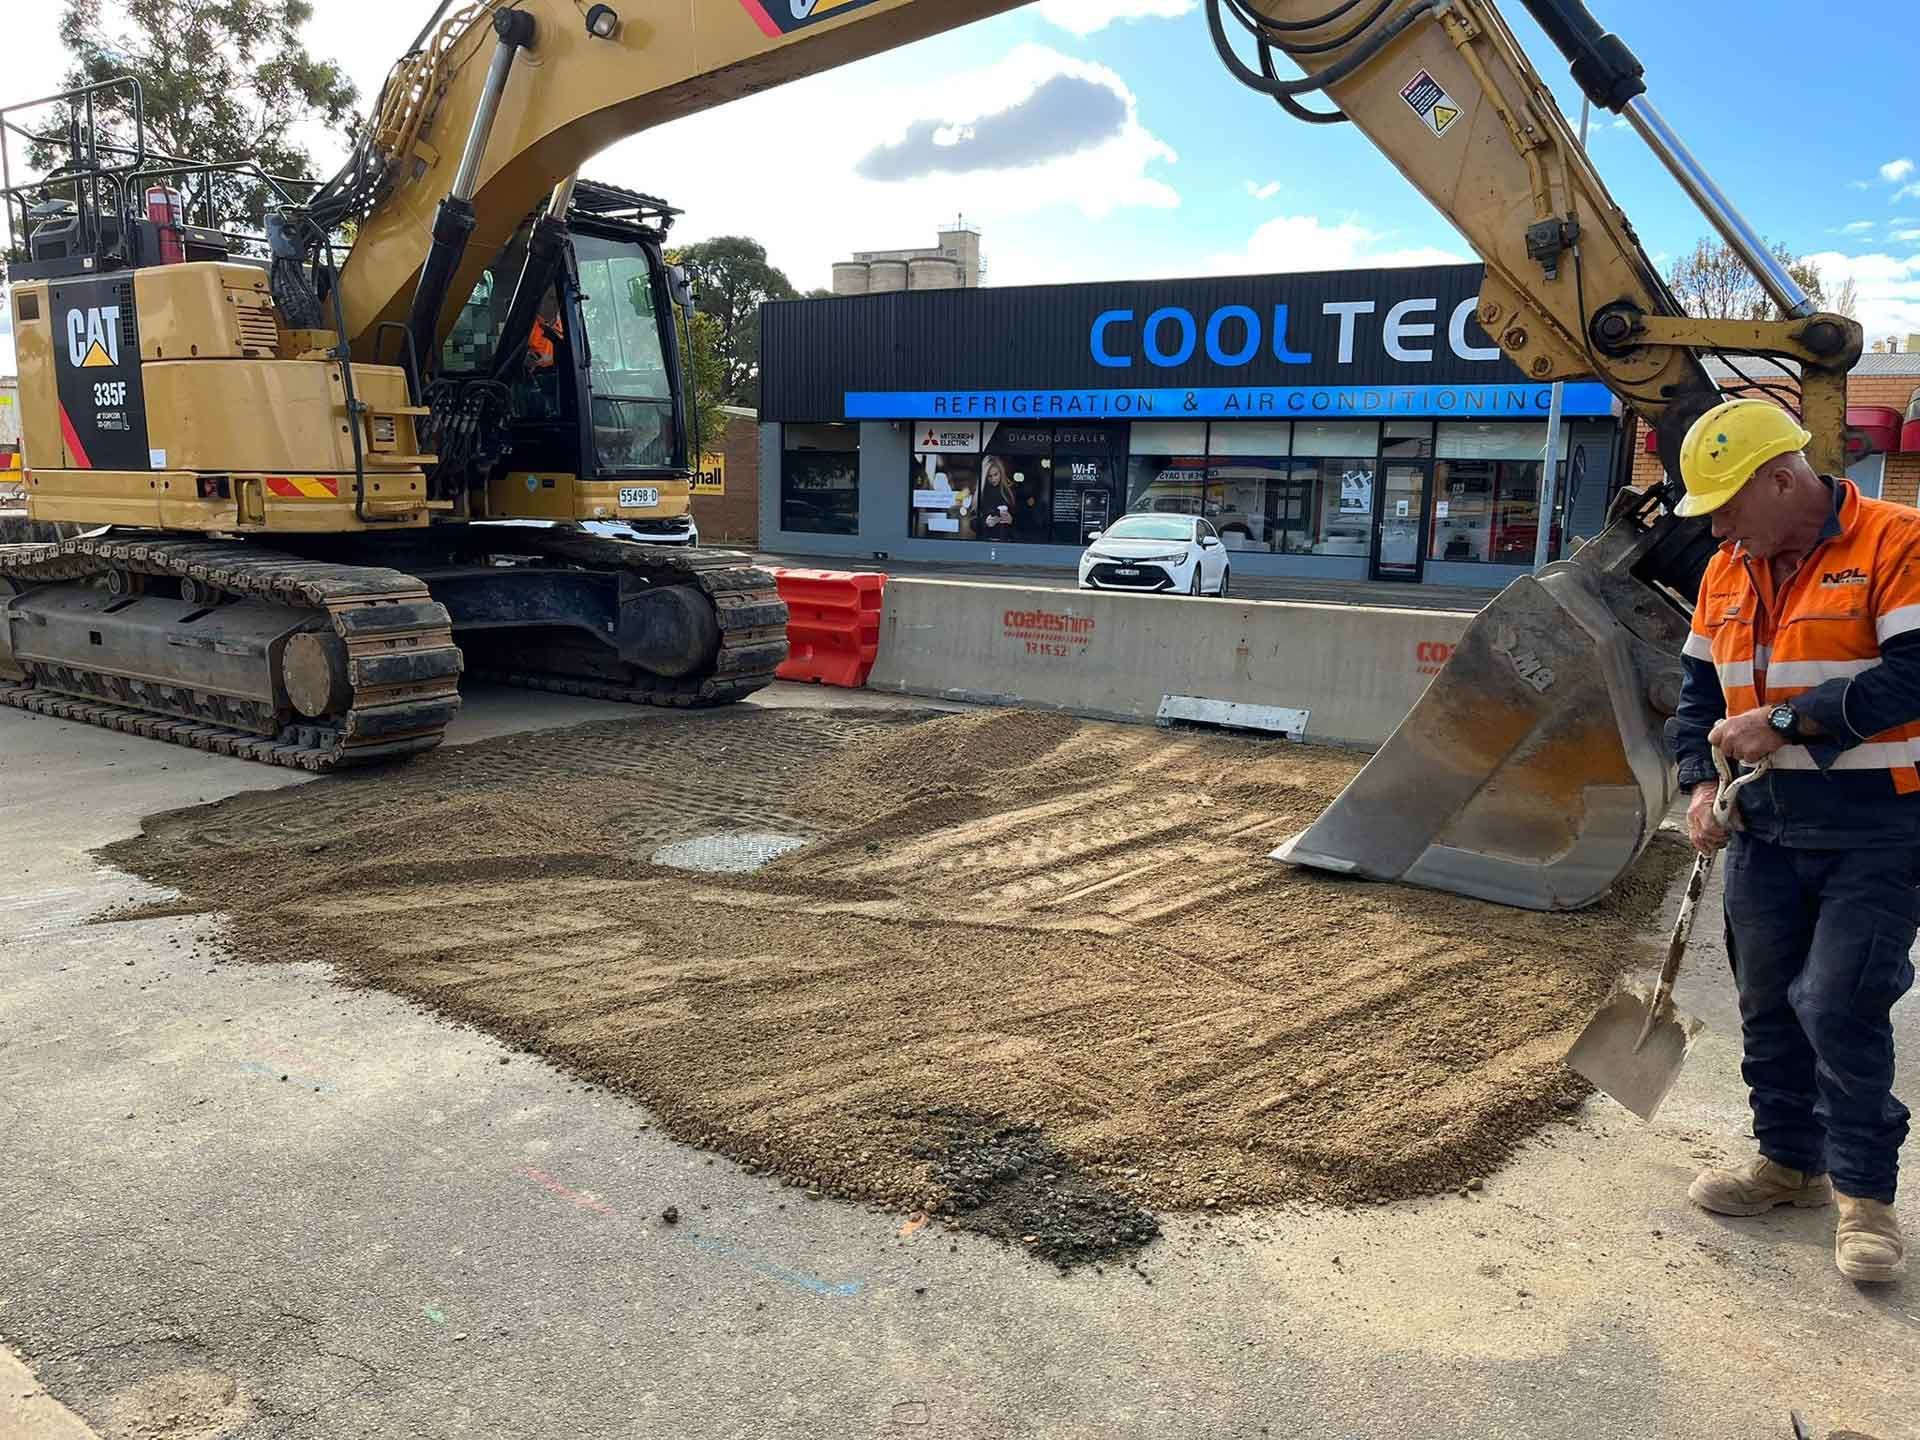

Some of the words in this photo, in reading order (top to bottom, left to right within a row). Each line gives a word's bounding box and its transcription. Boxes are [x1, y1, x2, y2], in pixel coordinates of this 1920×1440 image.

[67, 306, 119, 367] CAT
[93, 381, 126, 406] 335F
[934, 394, 1153, 415] REFRIGERATION
[1183, 392, 1199, 411] &
[1224, 391, 1274, 410] AIR
[1287, 389, 1553, 410] CONDITIONING
[1008, 433, 1061, 443] DIAMOND
[1064, 434, 1106, 443] DEALER
